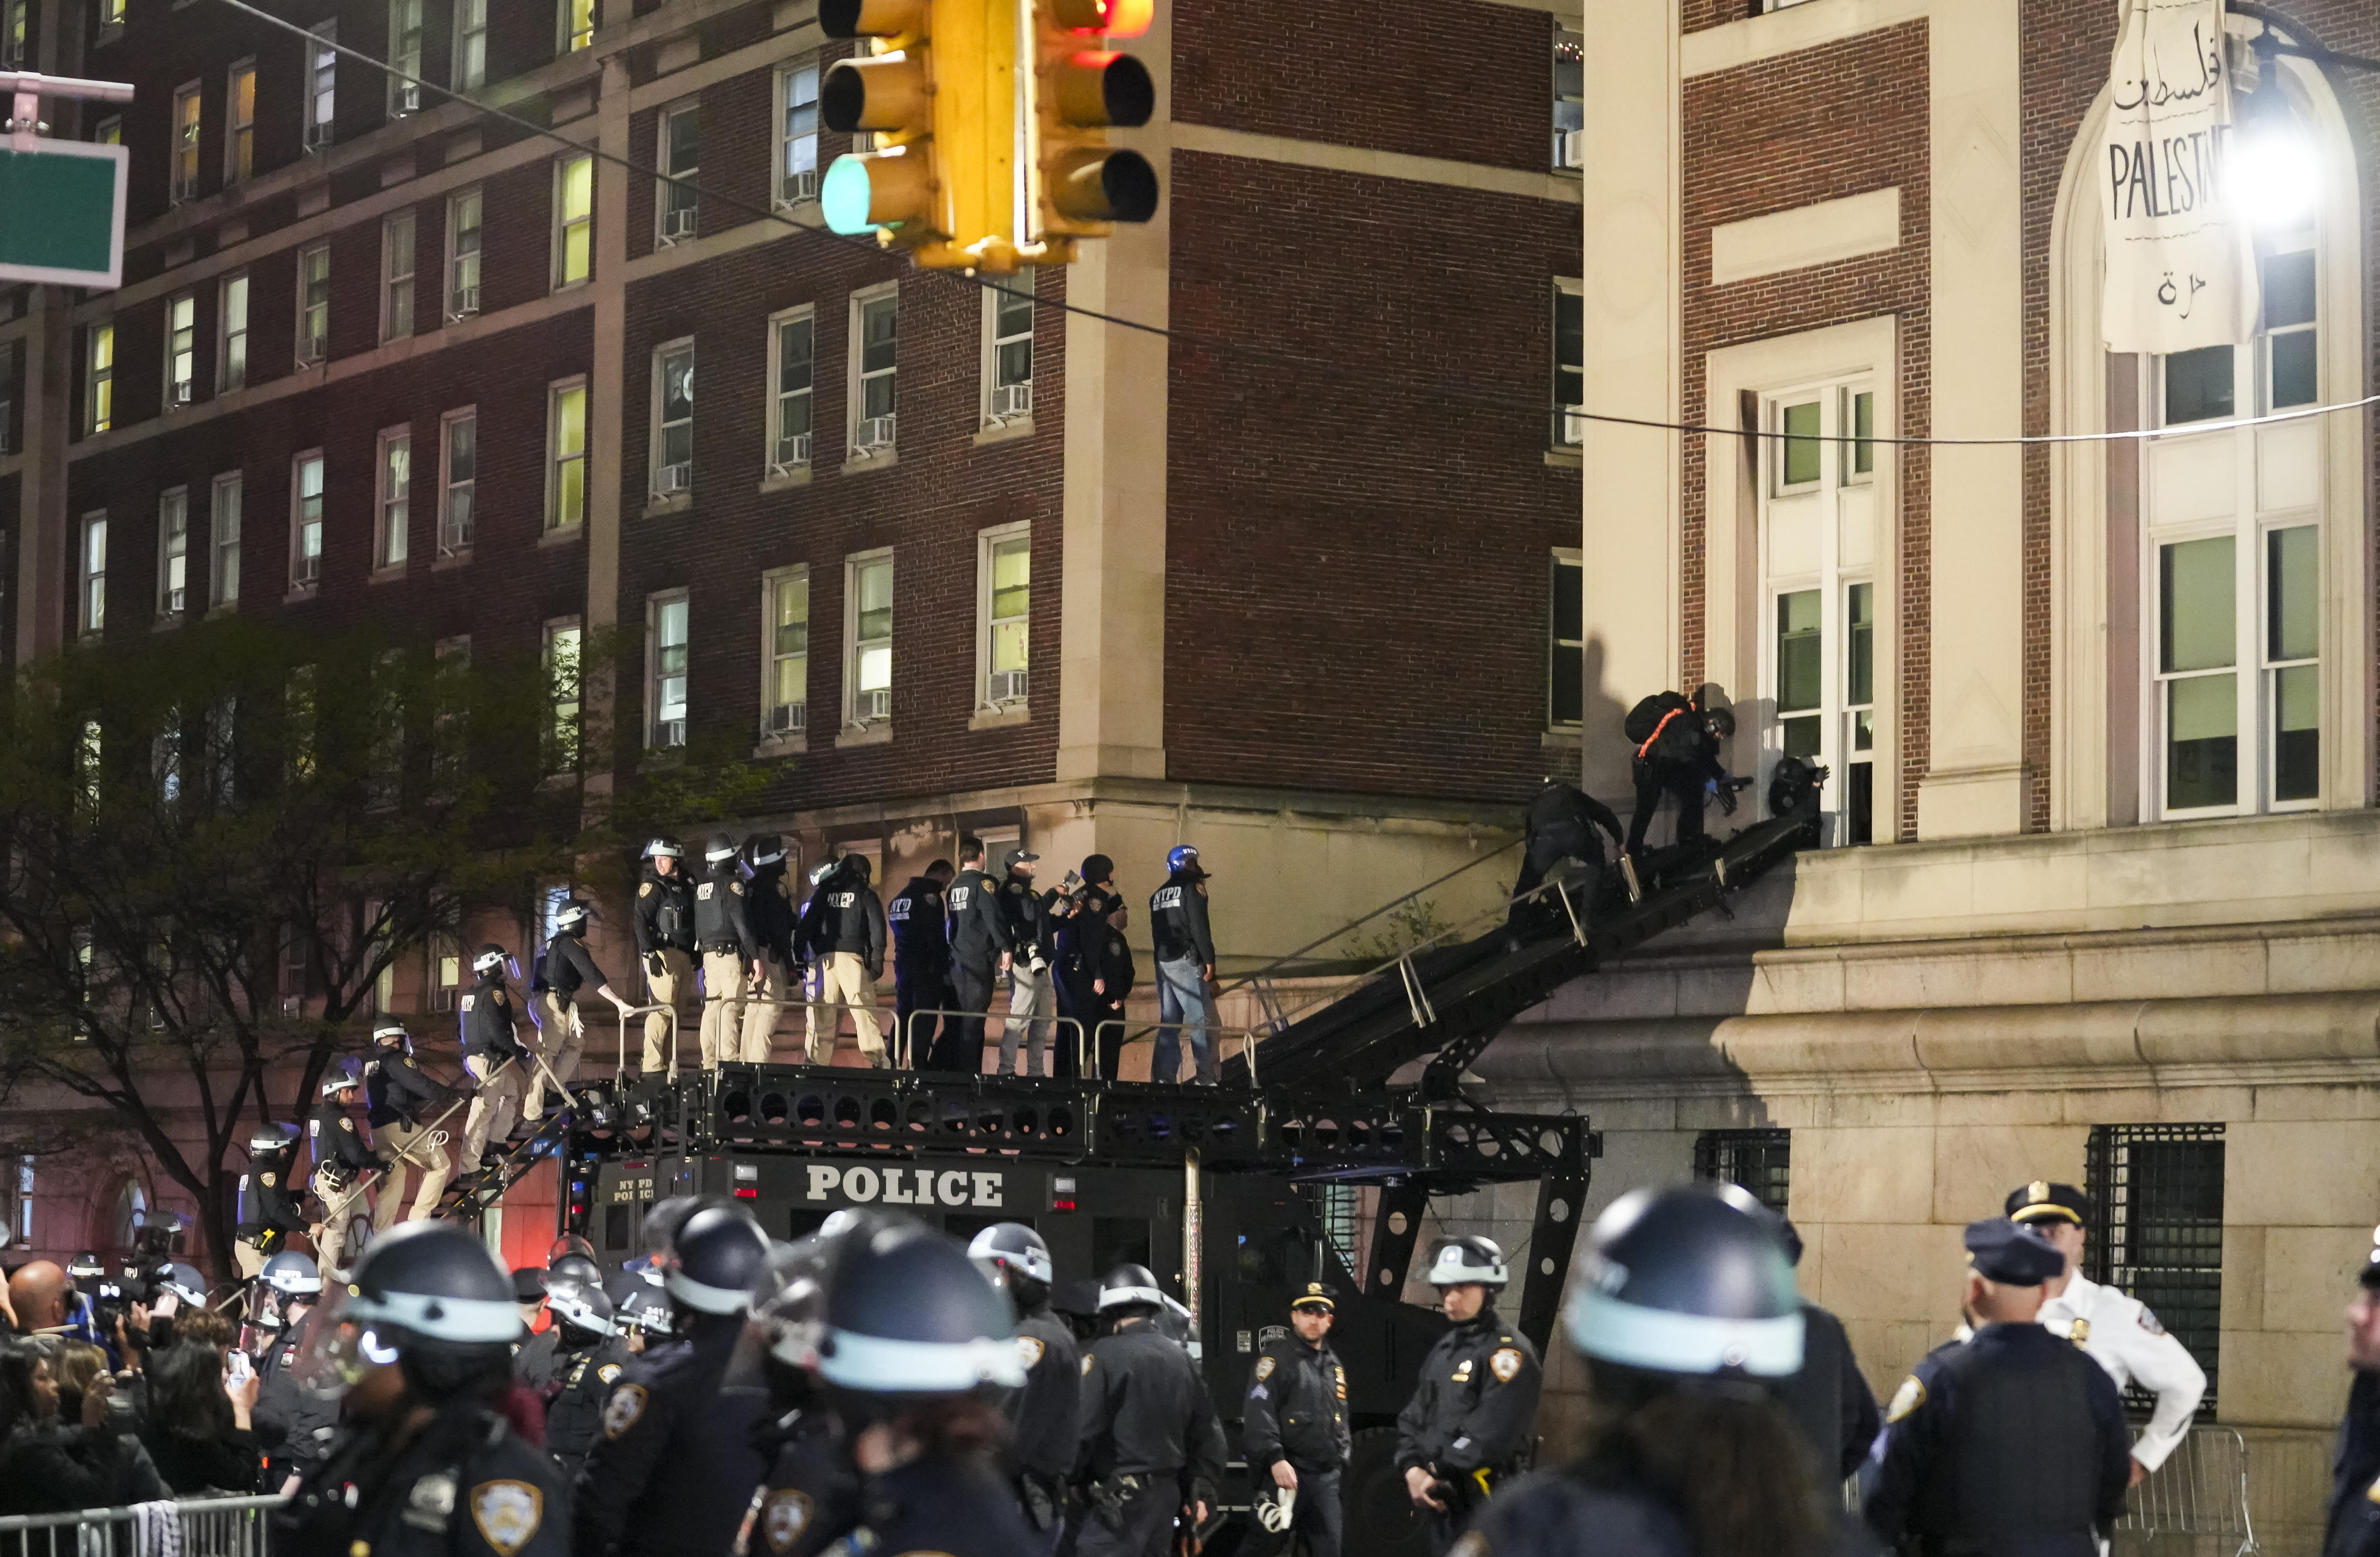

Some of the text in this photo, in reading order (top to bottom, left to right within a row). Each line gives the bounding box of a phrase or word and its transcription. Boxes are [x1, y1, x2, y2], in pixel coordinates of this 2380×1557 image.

[2114, 20, 2221, 110] فلسطين
[2158, 271, 2206, 320] حرة
[827, 892, 855, 903] NYPD
[1153, 887, 1182, 904] NYPD
[807, 1165, 1002, 1207] POLICE
